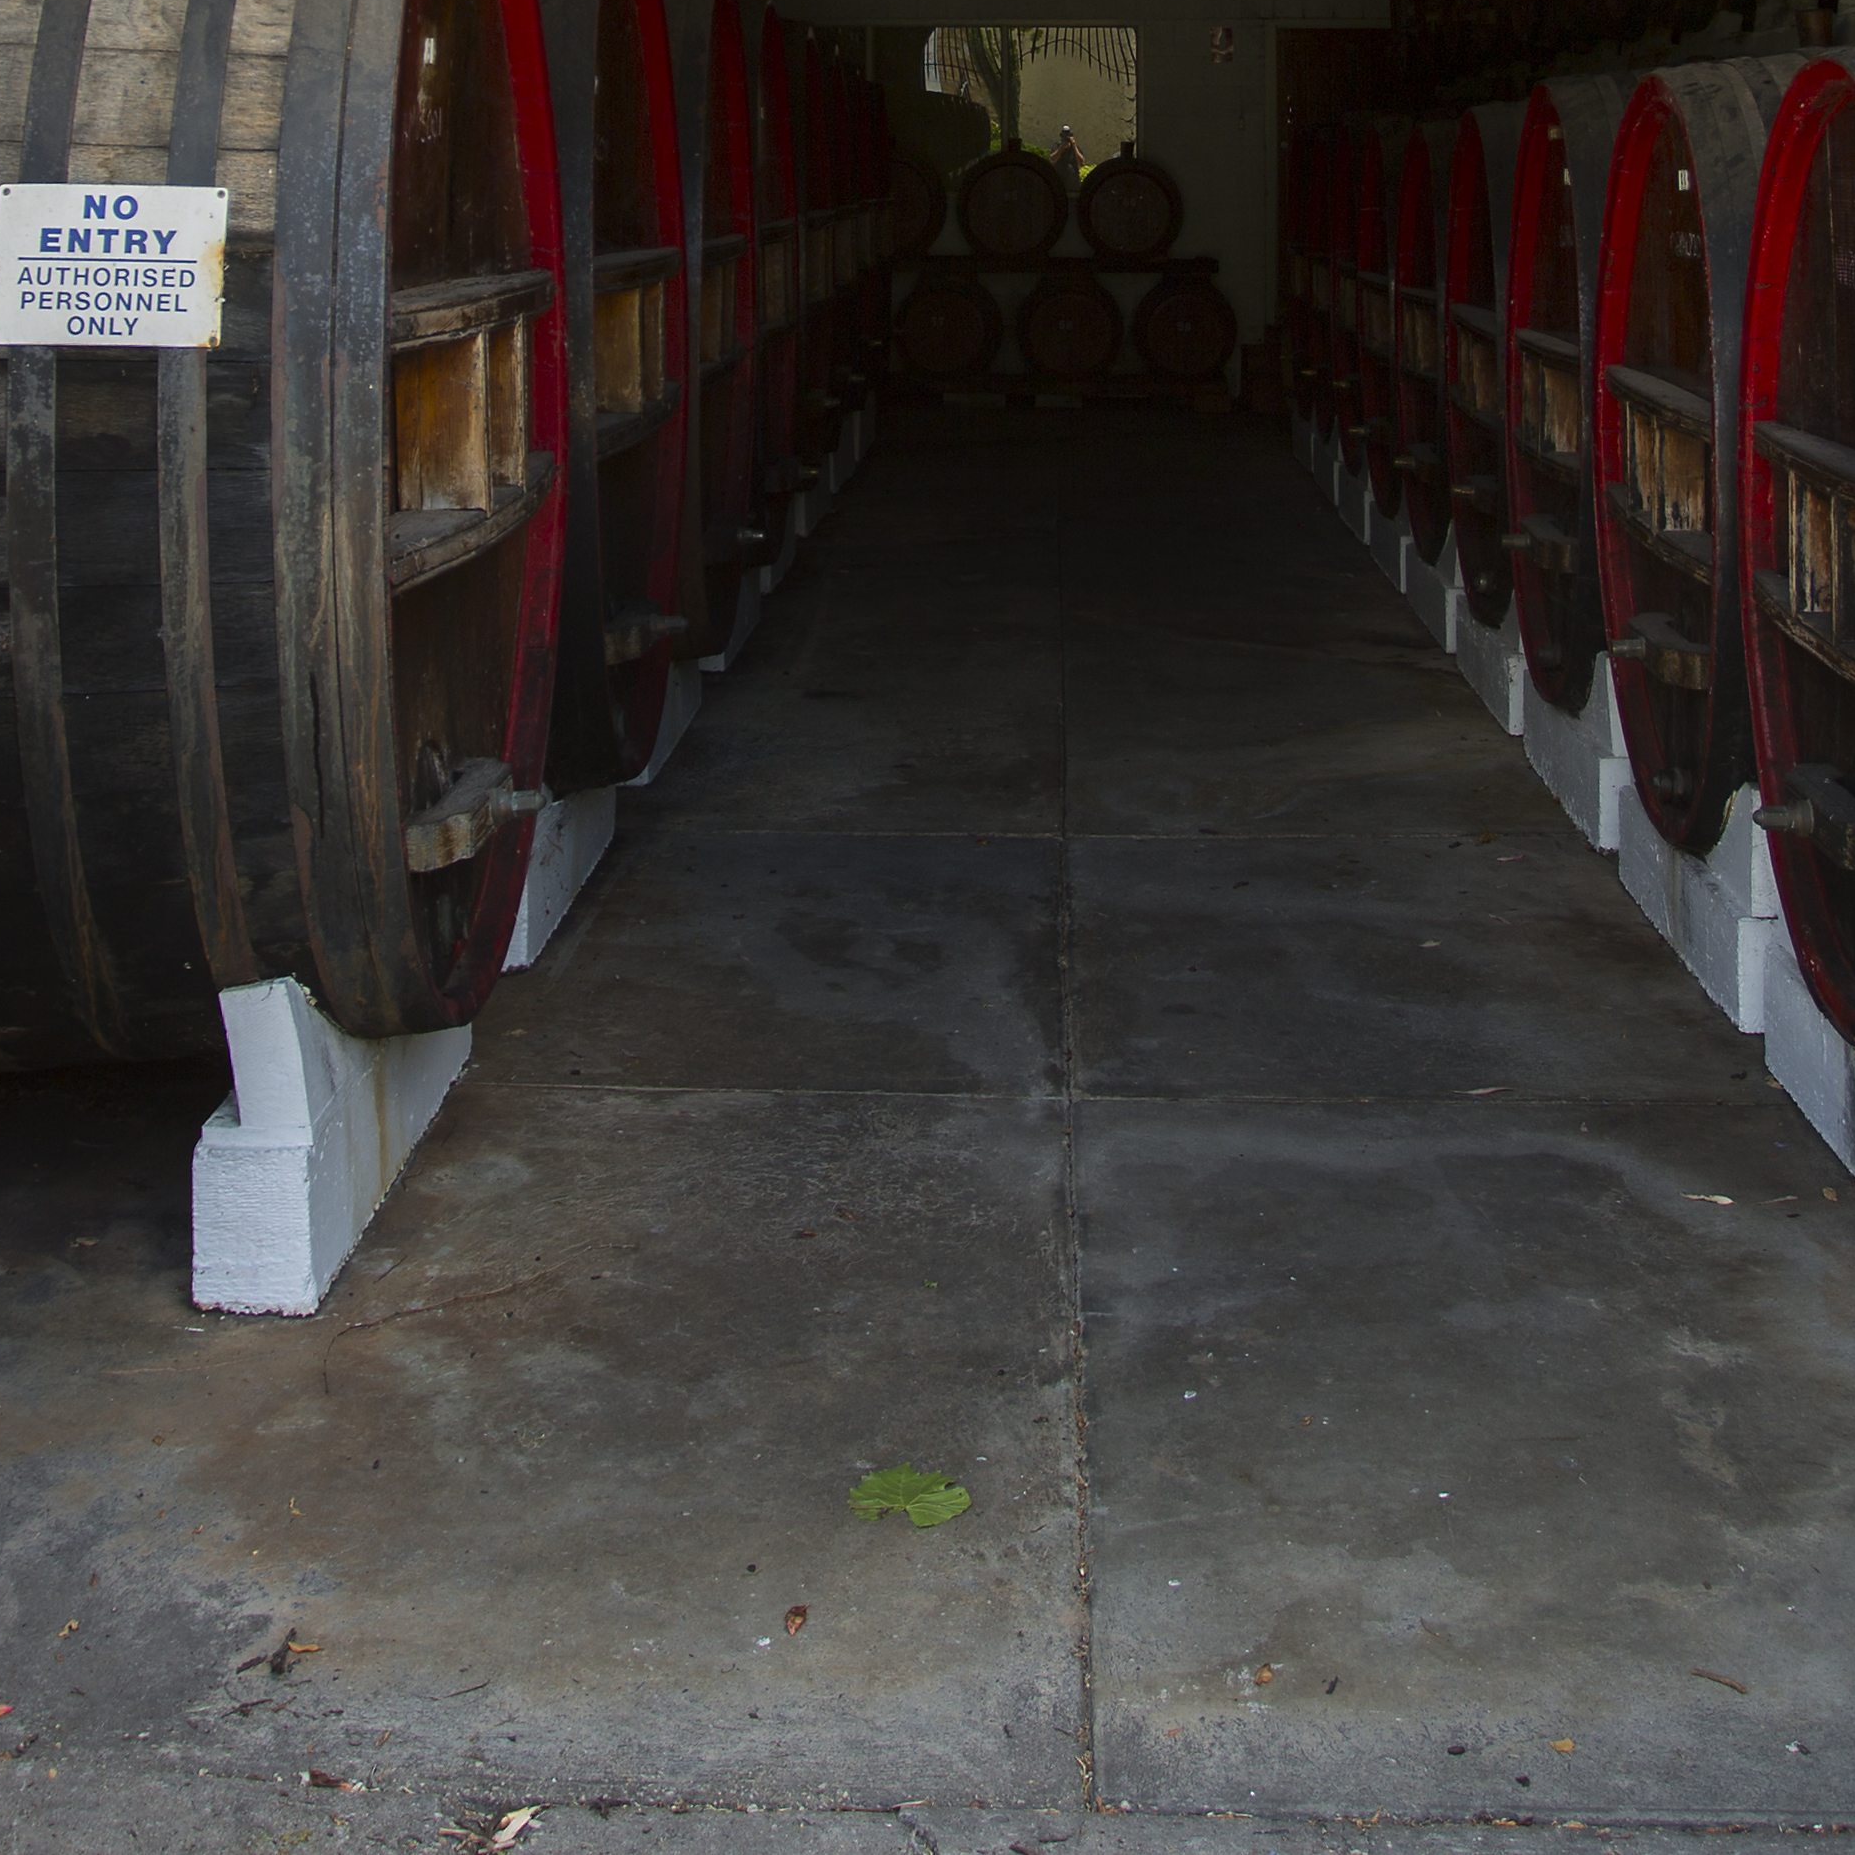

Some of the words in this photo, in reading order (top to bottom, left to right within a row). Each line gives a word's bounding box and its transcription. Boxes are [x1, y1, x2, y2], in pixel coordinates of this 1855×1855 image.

[82, 195, 139, 220] NO
[39, 228, 178, 254] ENTRY
[17, 267, 196, 288] AUTHORISED
[20, 292, 189, 312] PERSONNEL
[67, 316, 139, 336] ONLY
